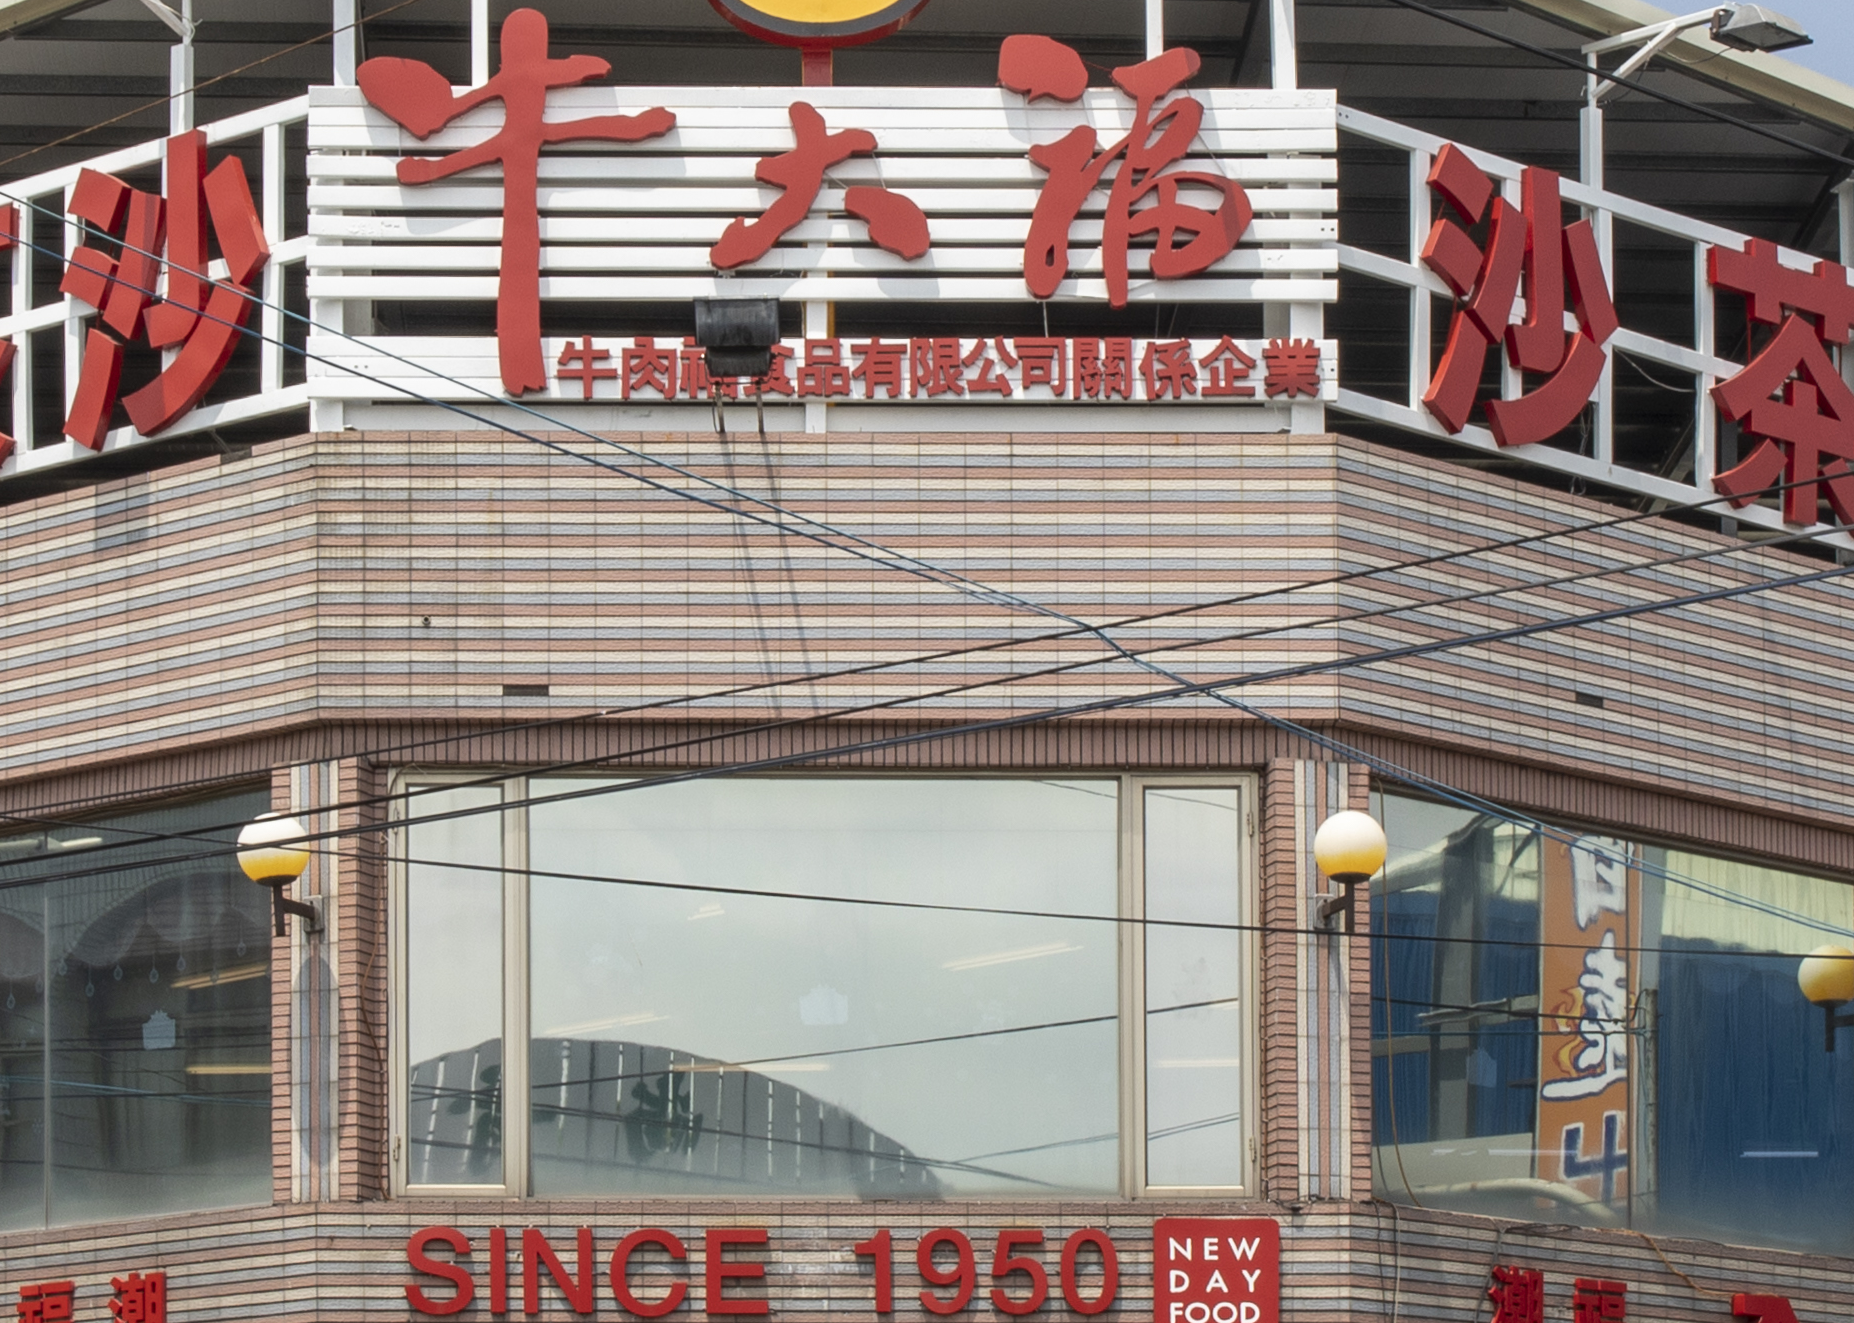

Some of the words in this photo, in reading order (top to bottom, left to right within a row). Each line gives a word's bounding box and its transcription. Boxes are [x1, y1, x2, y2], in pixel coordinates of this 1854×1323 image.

[356, 8, 1253, 395] 牛大福
[404, 1225, 772, 1317] SINCE
[854, 1227, 1121, 1317] 1950
[1168, 1236, 1262, 1262] NEW
[1168, 1269, 1262, 1293] DAY
